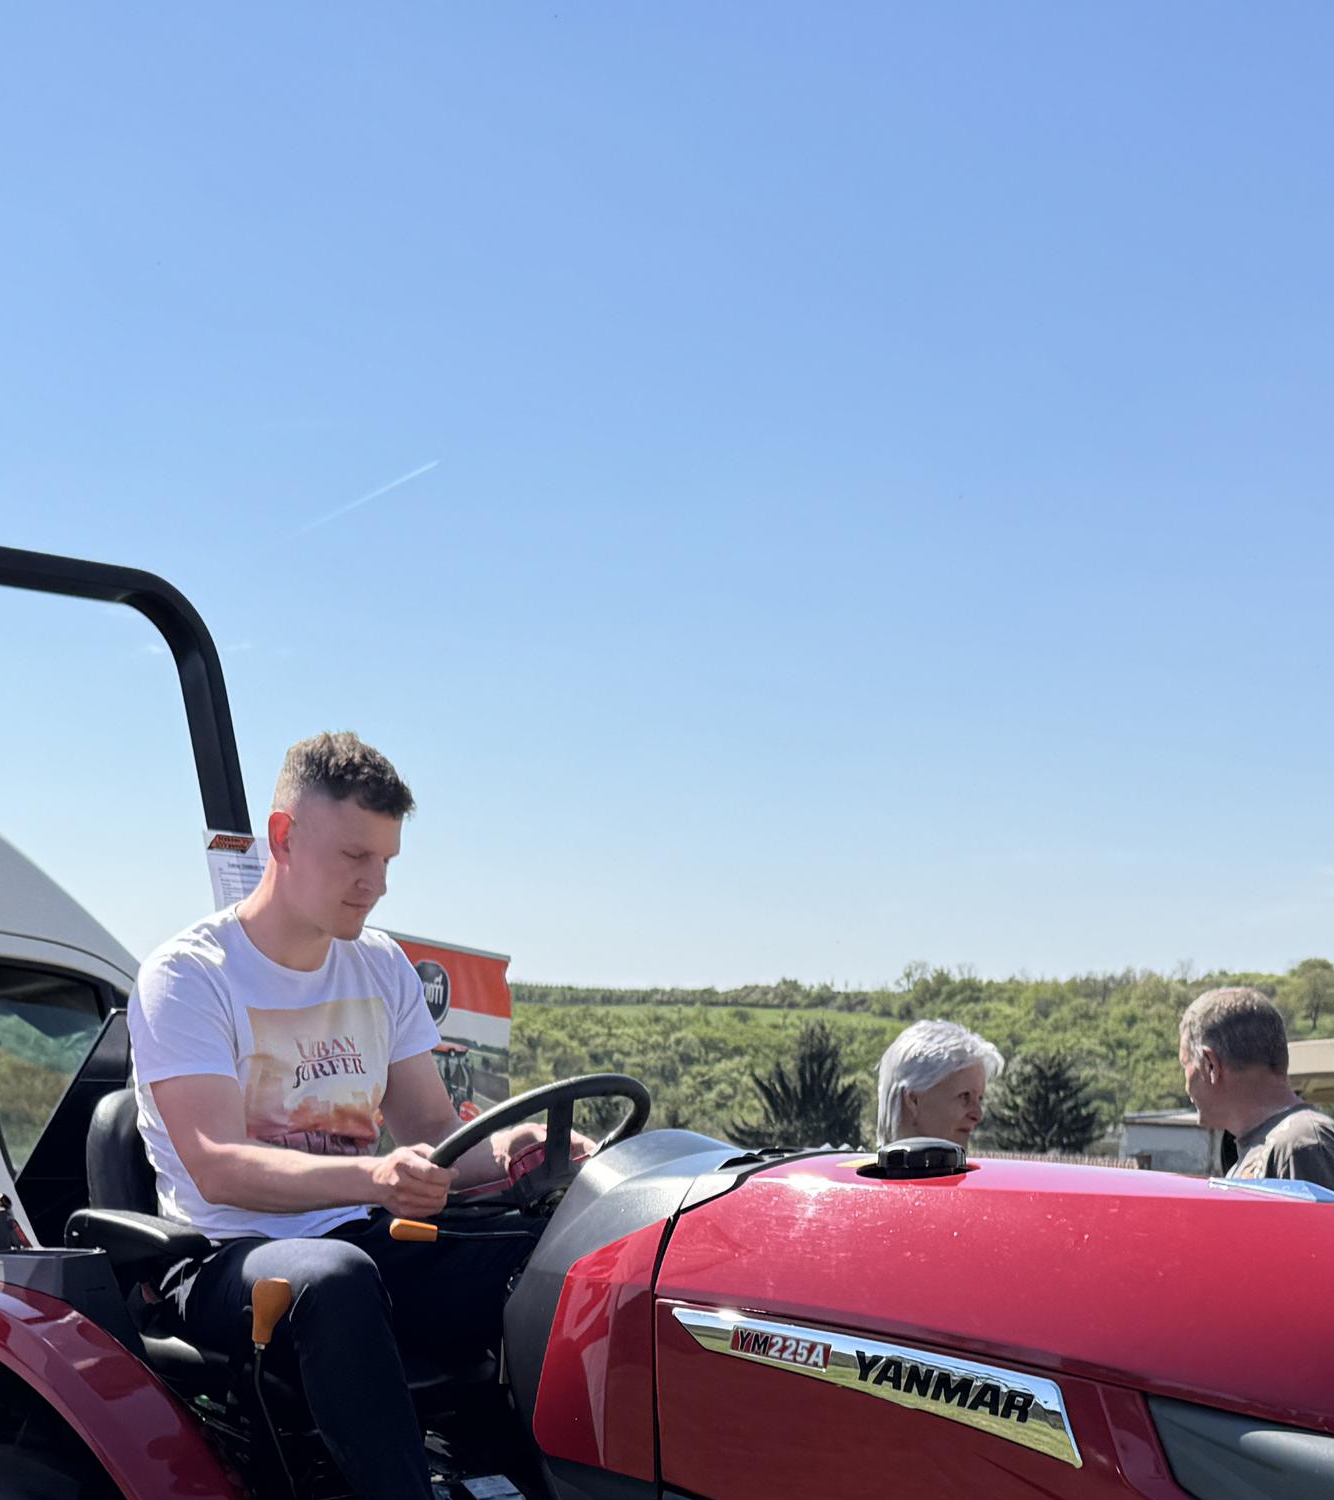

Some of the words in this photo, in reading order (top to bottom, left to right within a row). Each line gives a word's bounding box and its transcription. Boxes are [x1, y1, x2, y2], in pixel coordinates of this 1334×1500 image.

[293, 1057, 366, 1089] SURFER
[736, 1327, 826, 1369] YM225A
[855, 1350, 1035, 1424] YANMAR
